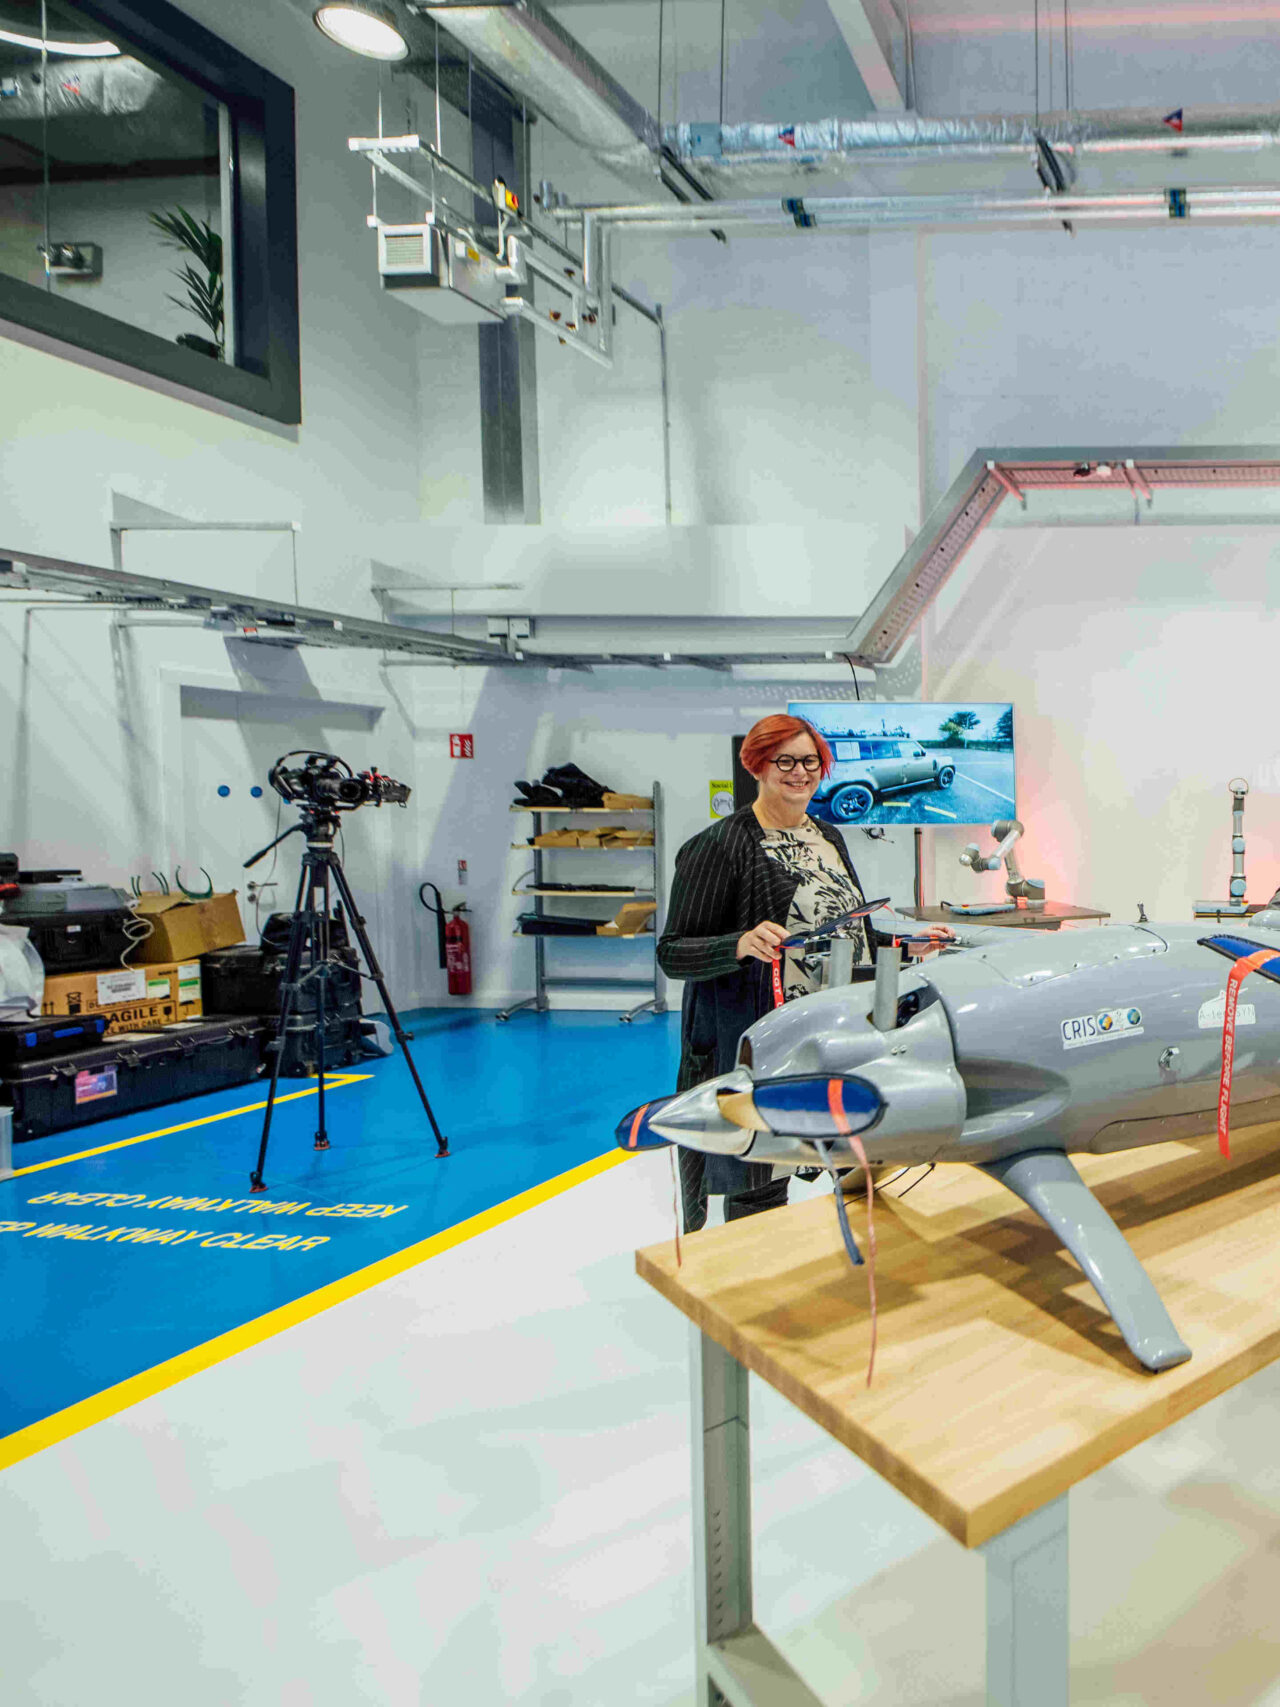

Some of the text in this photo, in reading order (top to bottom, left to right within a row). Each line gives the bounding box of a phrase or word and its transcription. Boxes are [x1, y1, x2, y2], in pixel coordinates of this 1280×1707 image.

[107, 1007, 158, 1023] AGILE
[1062, 1017, 1096, 1041] CRIS
[1220, 979, 1238, 1135] REMOVE BEFORE FLIGHT
[27, 1192, 409, 1218] KEEP WALKWAY CLEAR
[23, 1222, 215, 1245] WALKWAY
[200, 1231, 331, 1251] CLEAR
